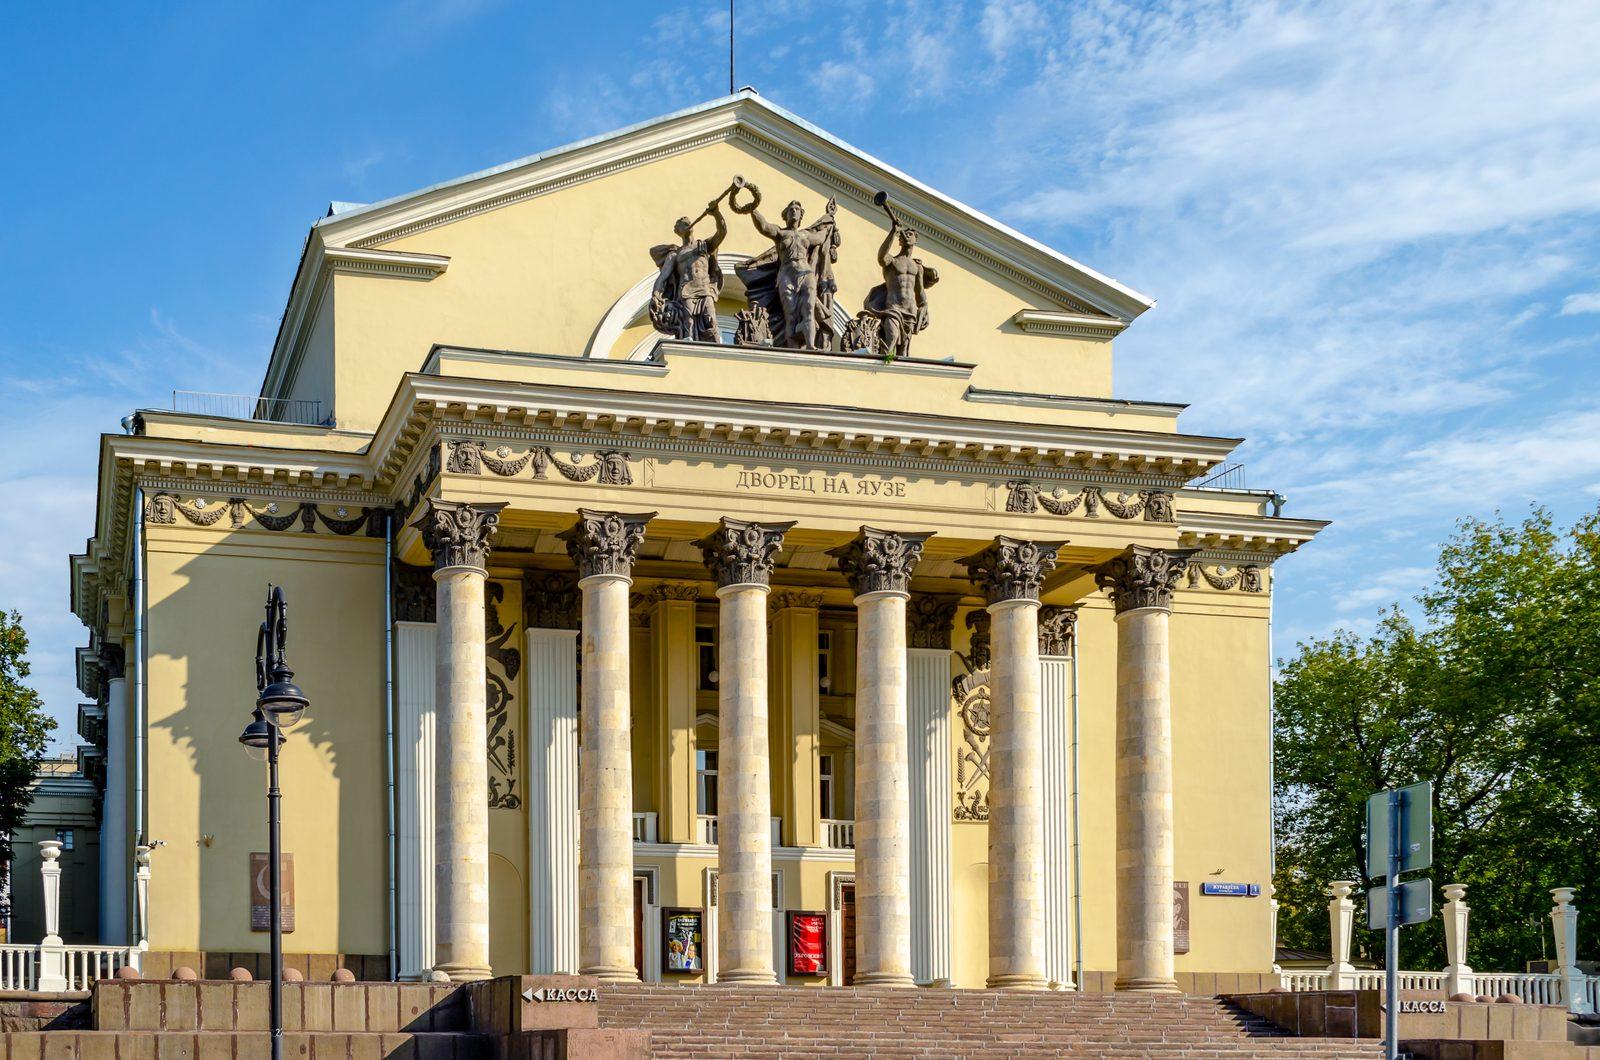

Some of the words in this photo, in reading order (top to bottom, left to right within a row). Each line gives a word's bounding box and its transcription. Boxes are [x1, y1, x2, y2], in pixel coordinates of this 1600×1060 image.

[736, 471, 815, 494] ДВОРЕЦ
[823, 477, 850, 494] НА
[857, 480, 906, 497] ЯУЗЕ
[546, 988, 598, 1001] КАССА
[1402, 1000, 1447, 1013] КАССА
